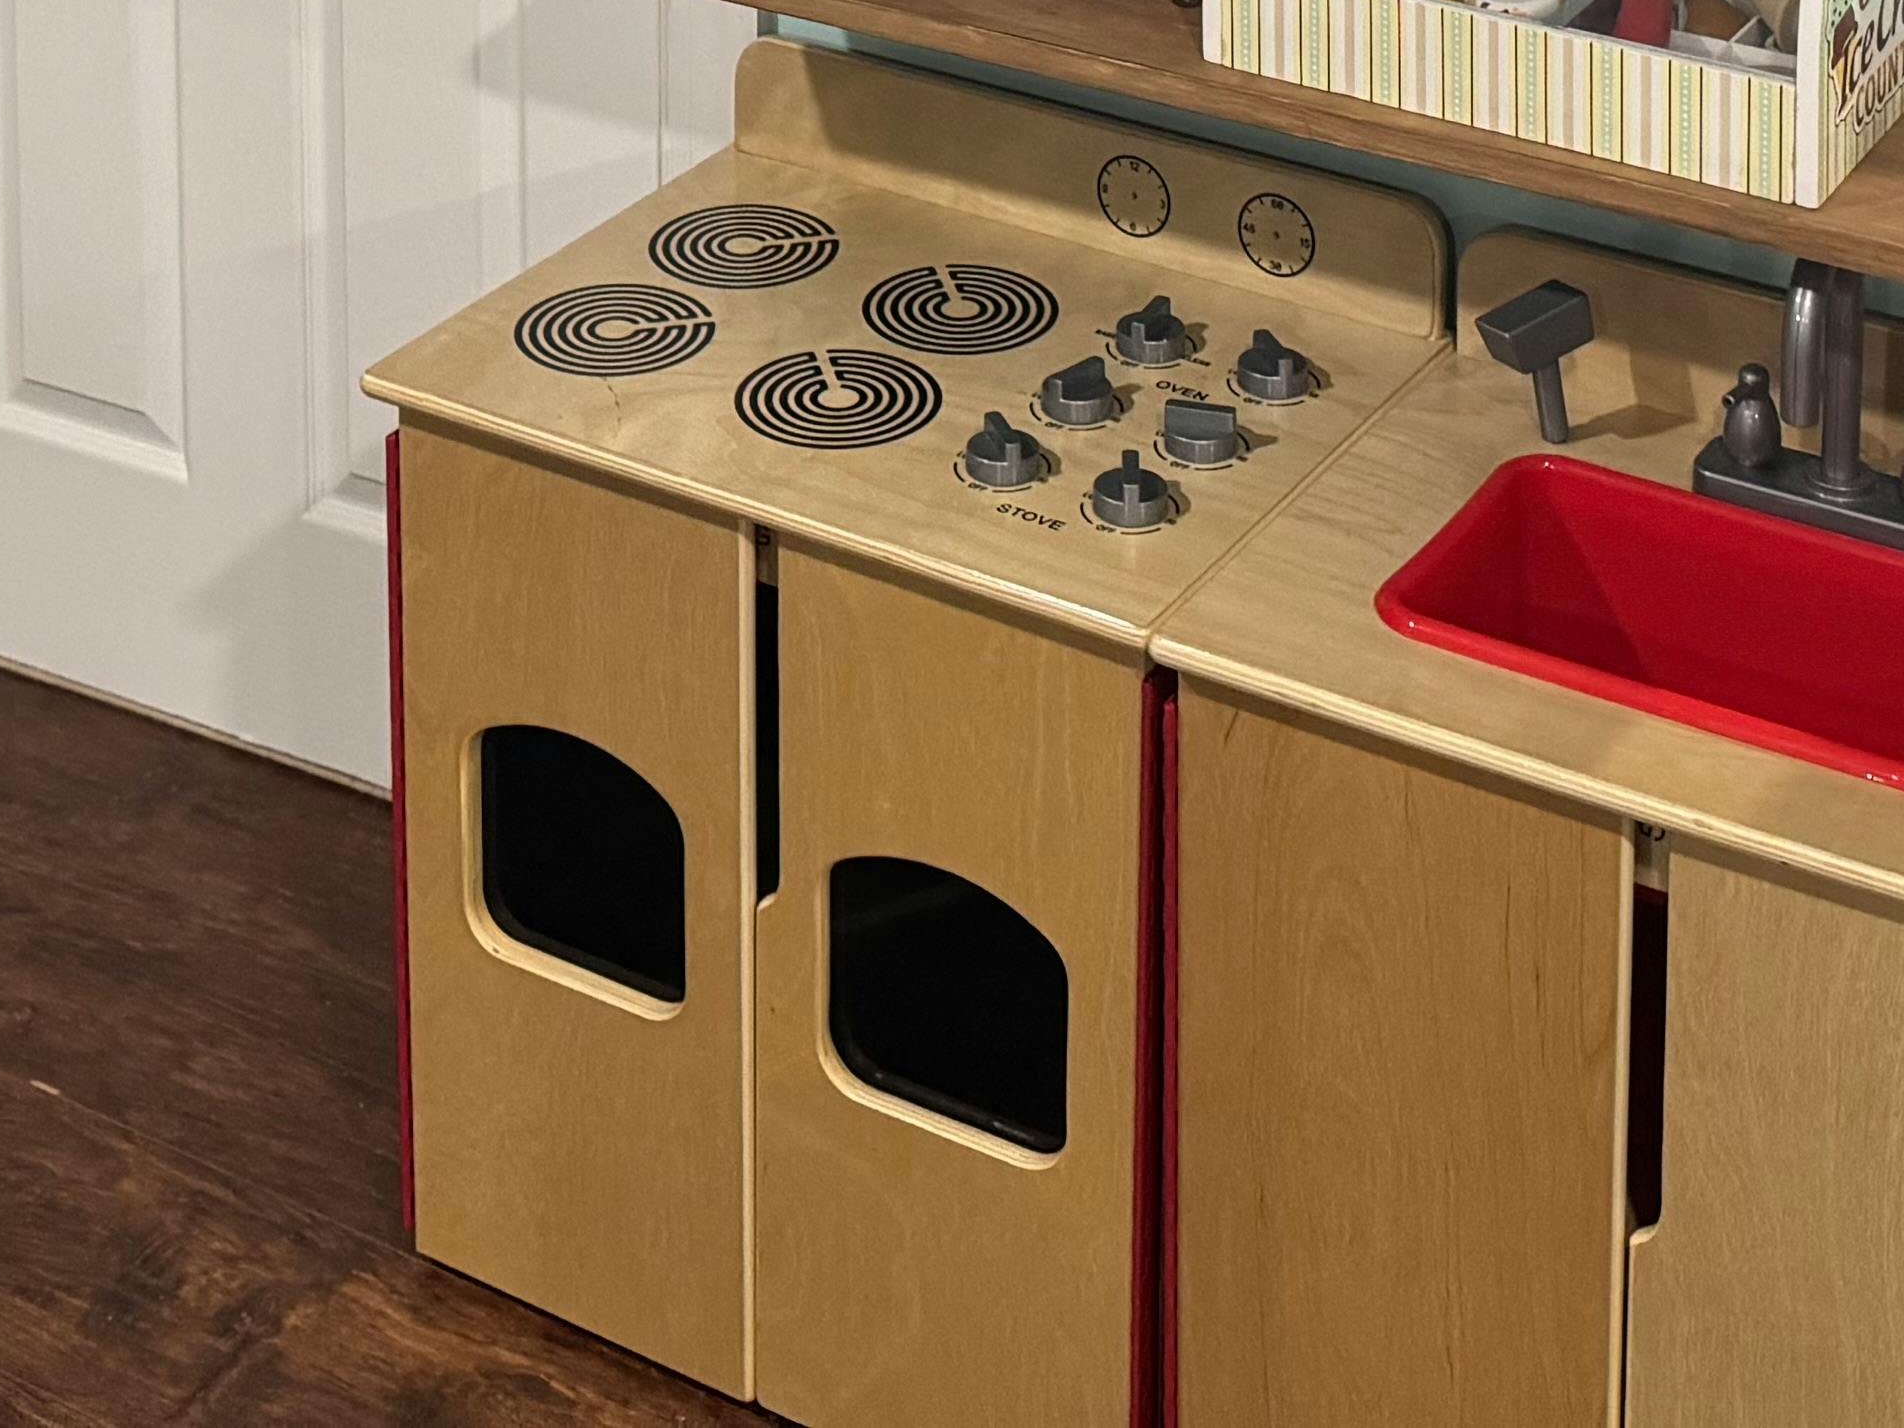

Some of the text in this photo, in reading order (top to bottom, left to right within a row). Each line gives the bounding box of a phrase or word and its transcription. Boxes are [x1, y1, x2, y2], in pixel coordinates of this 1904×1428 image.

[1838, 19, 1875, 116] Ice
[1156, 380, 1209, 401] OVEN
[996, 503, 1067, 532] STOVE
